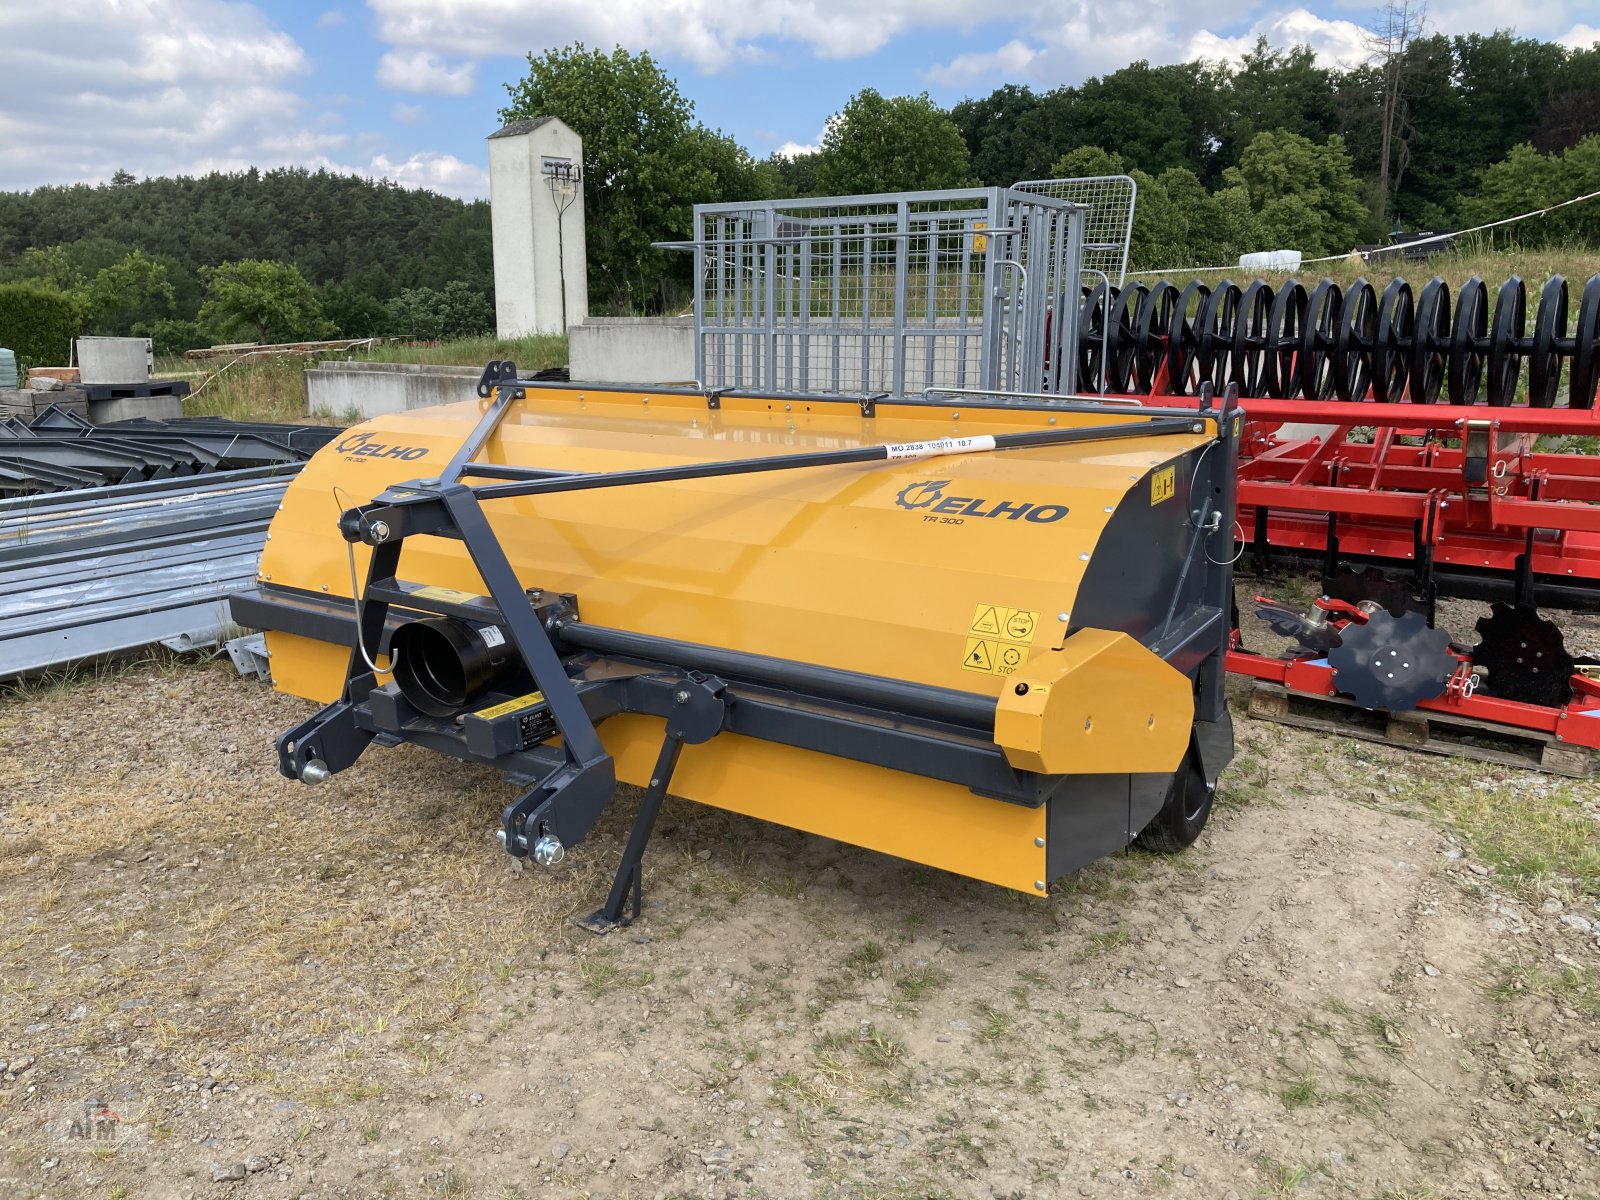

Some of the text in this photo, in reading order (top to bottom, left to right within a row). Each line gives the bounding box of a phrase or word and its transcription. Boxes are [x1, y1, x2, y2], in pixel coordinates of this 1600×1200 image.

[352, 443, 429, 461] ELHO
[930, 496, 1070, 524] ELHO
[940, 517, 965, 526] 300
[998, 666, 1016, 674] STO
